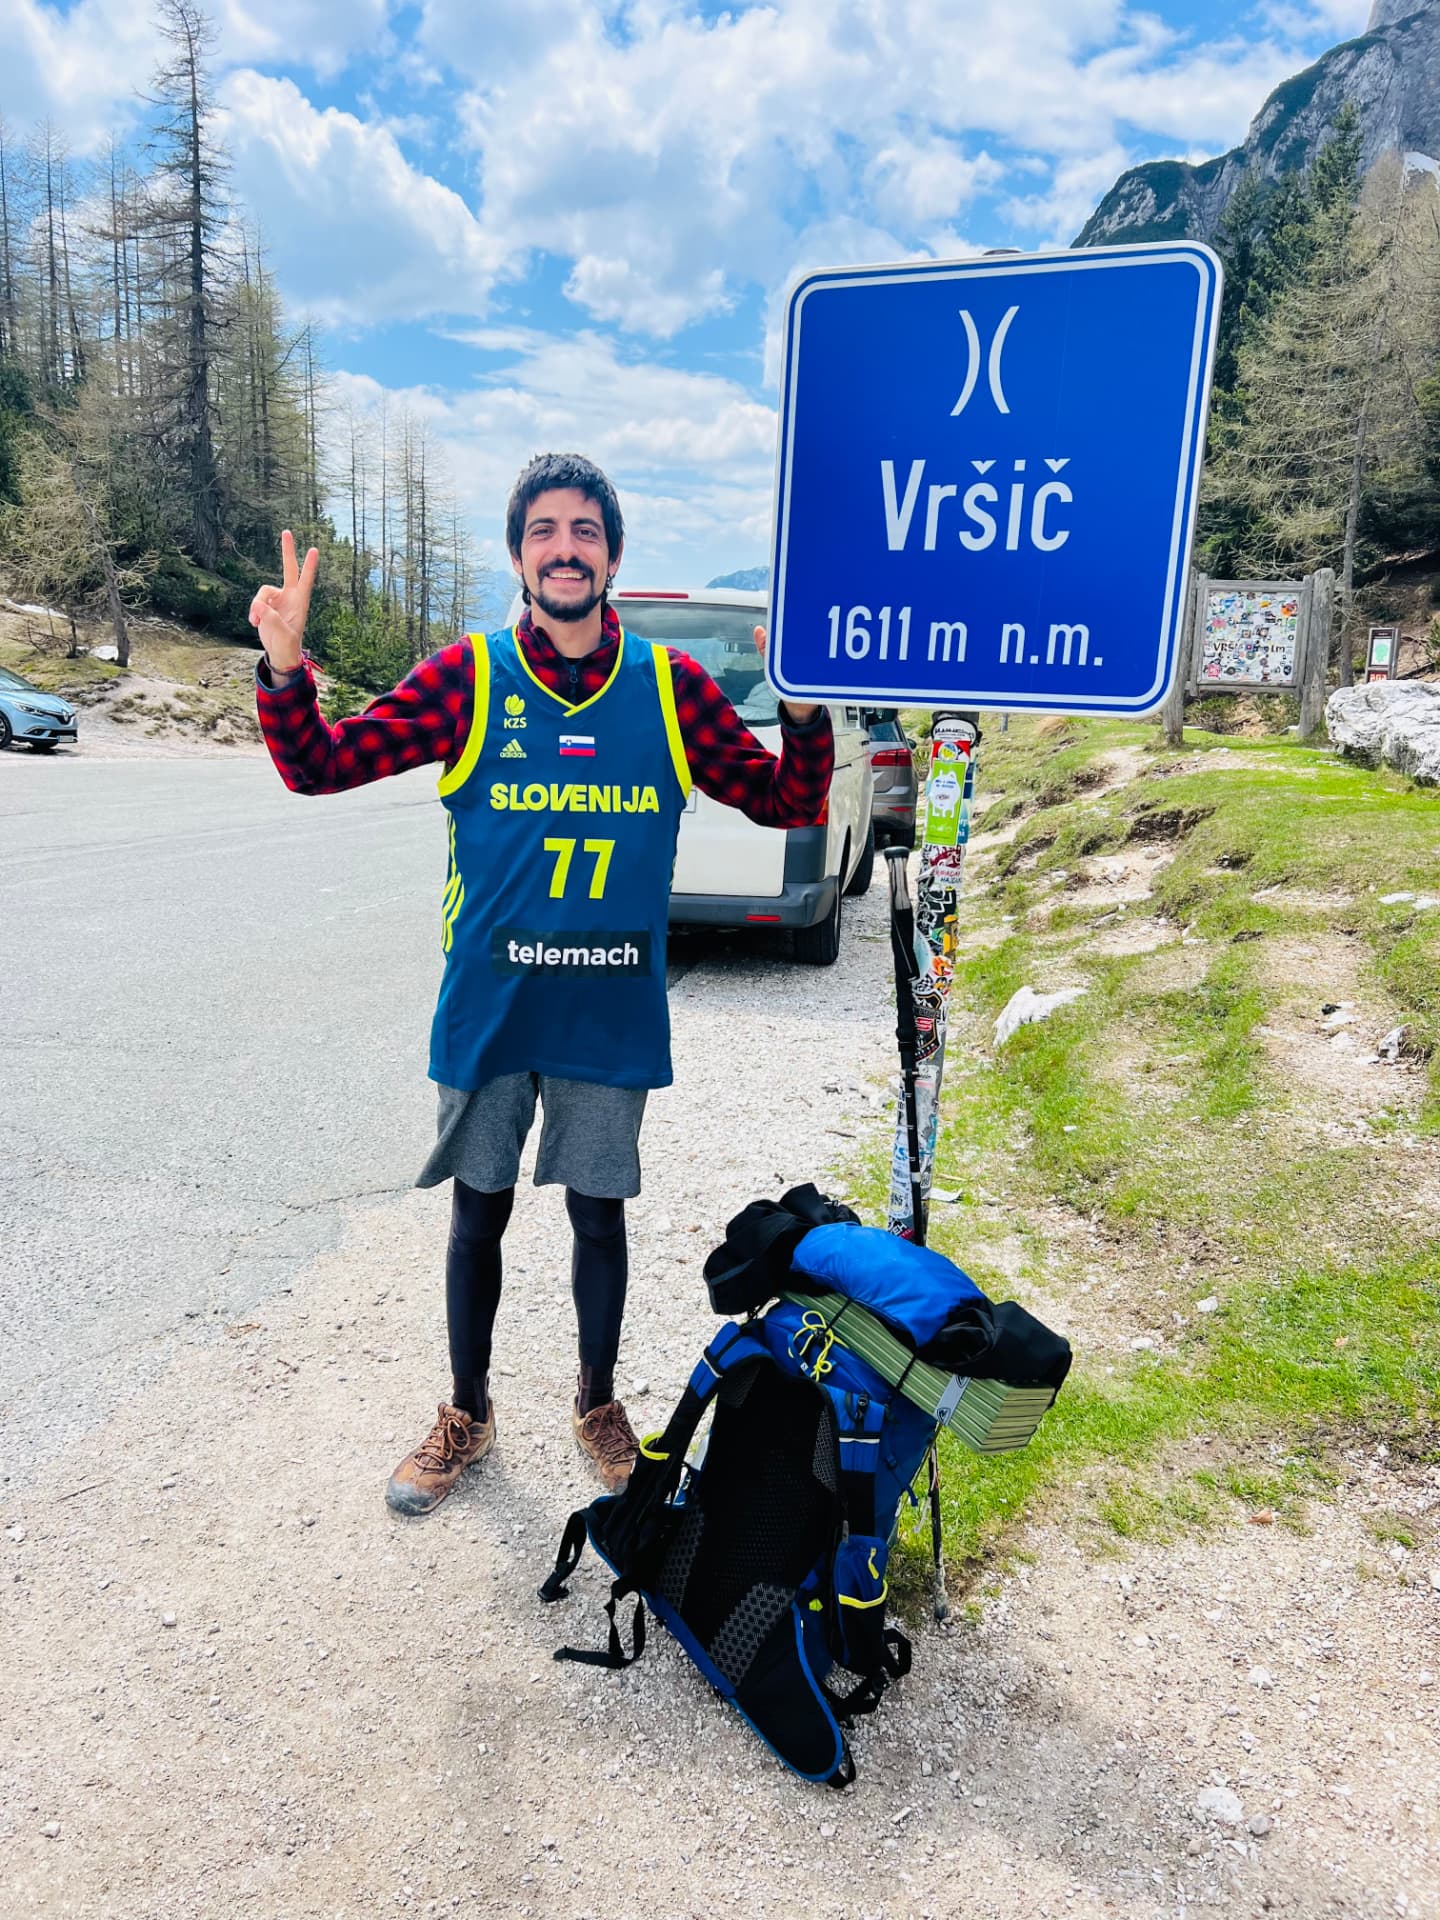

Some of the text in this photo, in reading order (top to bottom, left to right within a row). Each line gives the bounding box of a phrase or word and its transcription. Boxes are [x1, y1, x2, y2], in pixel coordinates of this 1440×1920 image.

[880, 458, 1073, 552] Vršič
[827, 605, 1104, 667] 1611 m n.m.
[503, 717, 527, 729] KZS
[489, 783, 660, 813] SLOVENIJA
[543, 837, 616, 899] 77
[507, 940, 639, 966] telemach
